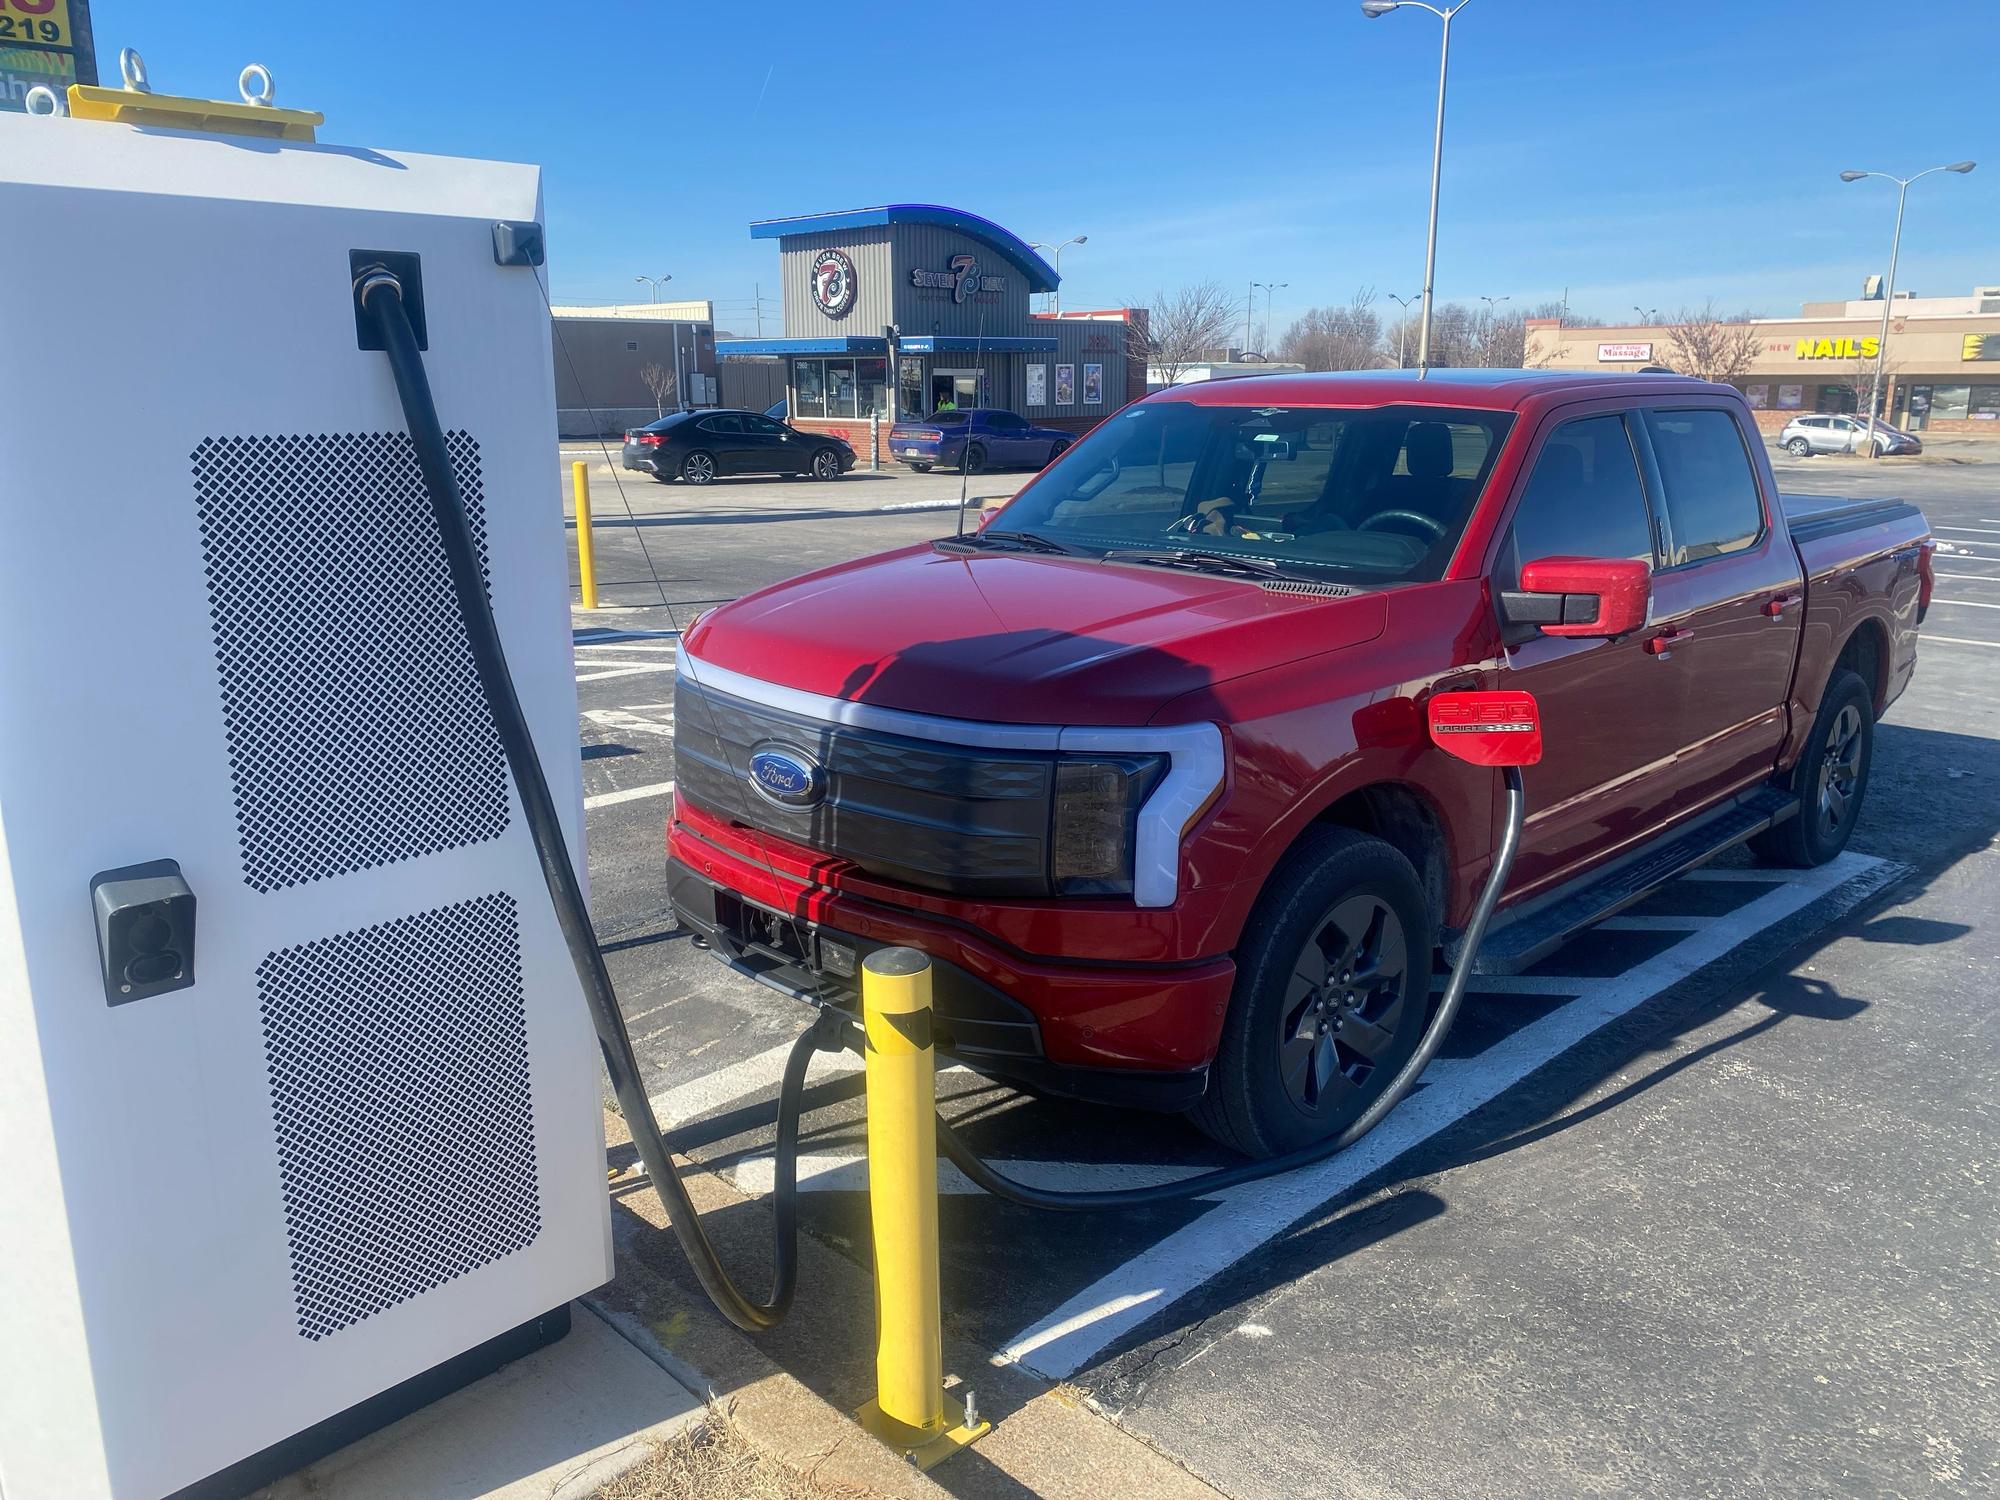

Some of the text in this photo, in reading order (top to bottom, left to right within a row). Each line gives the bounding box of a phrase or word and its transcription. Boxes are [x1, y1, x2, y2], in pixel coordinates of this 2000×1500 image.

[813, 251, 848, 274] SEVEN BREW
[813, 289, 850, 315] DRIVE THRU COFFEE
[1603, 349, 1647, 358] Massage
[1769, 336, 1880, 359] NEW NAILS
[1433, 701, 1534, 722] F-150
[1436, 724, 1481, 732] LARIAT
[761, 760, 796, 788] Ford
